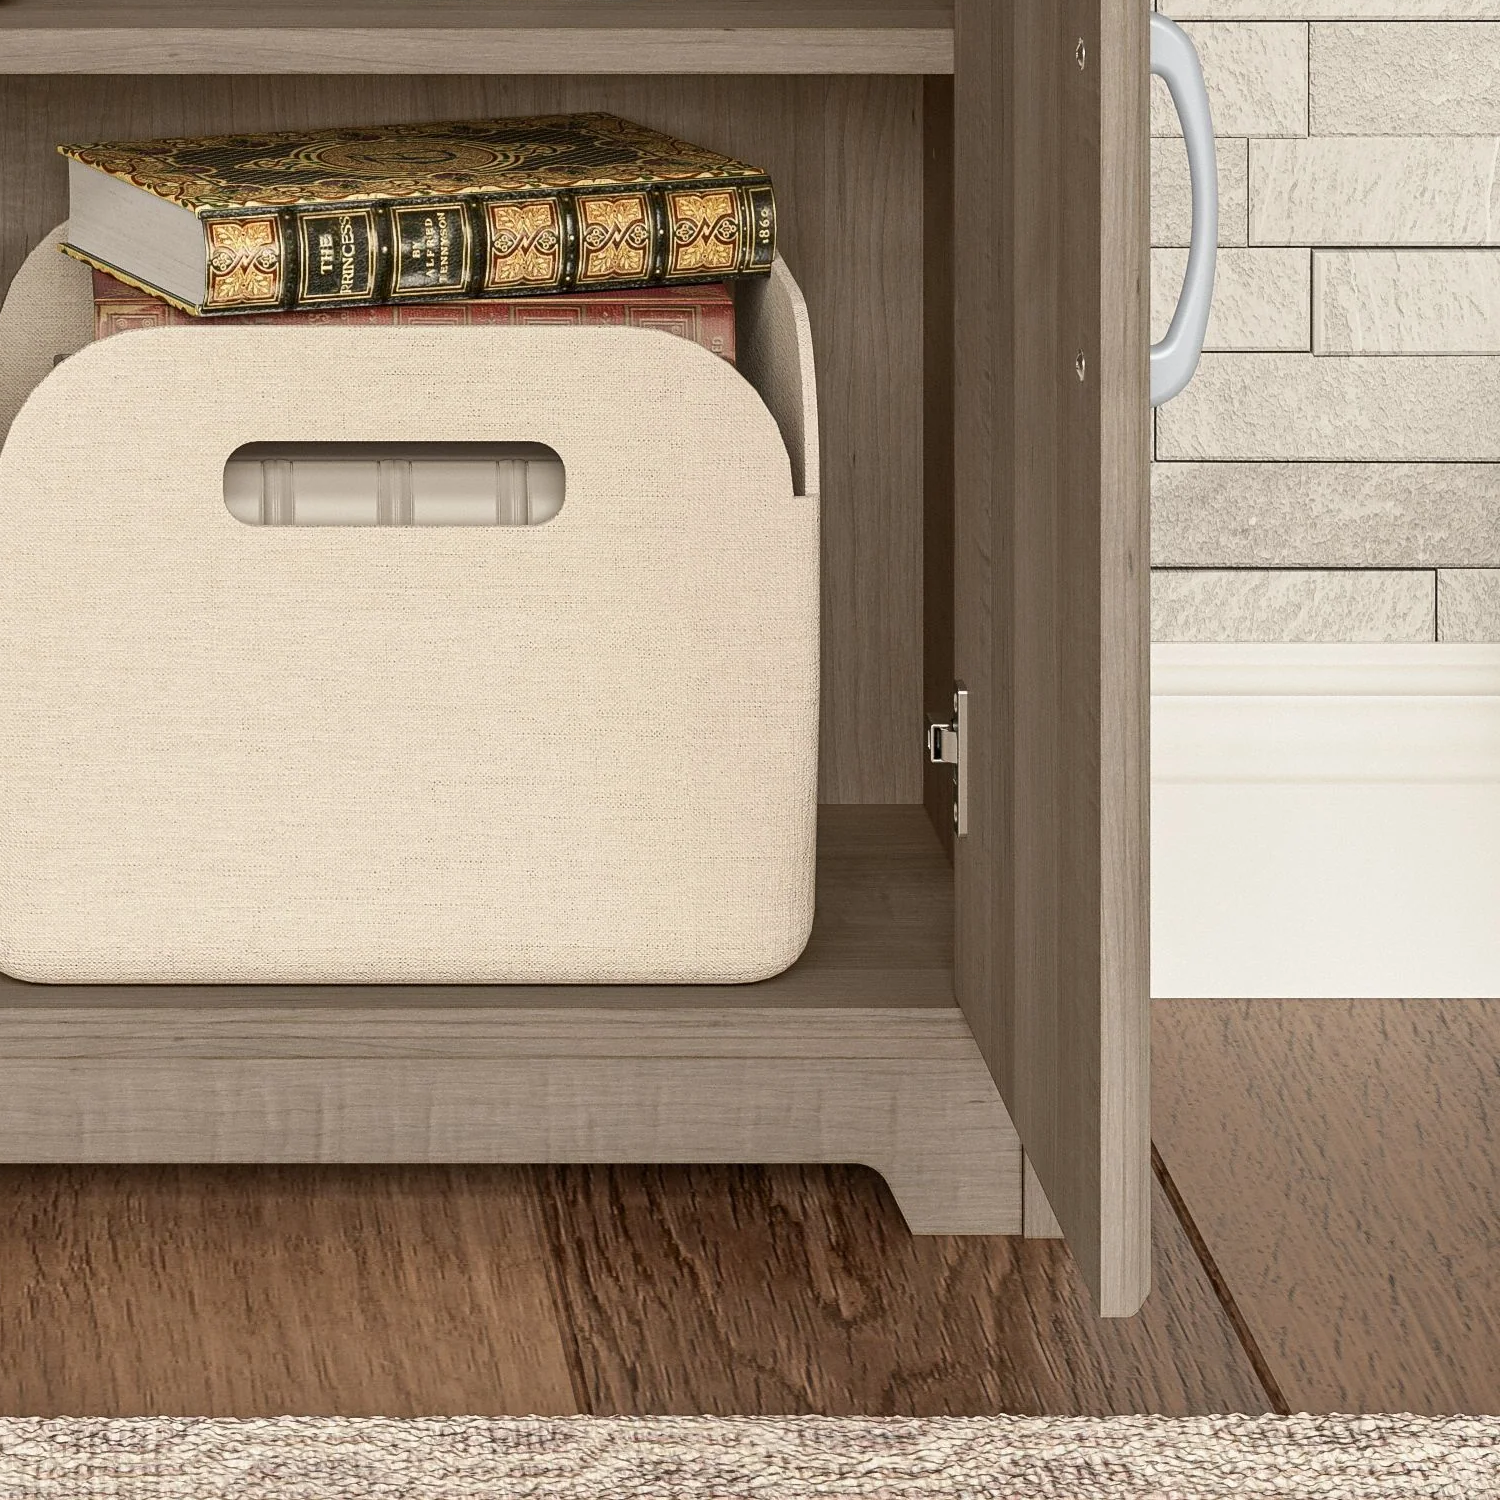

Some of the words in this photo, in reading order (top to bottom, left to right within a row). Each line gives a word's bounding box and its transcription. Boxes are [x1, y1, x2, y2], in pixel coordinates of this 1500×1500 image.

[412, 241, 421, 259] BY
[424, 218, 436, 278] ALFRED
[437, 212, 449, 284] TENNYSON
[759, 206, 771, 244] 1860
[319, 233, 335, 275] THE
[339, 215, 356, 295] PRINCESS
